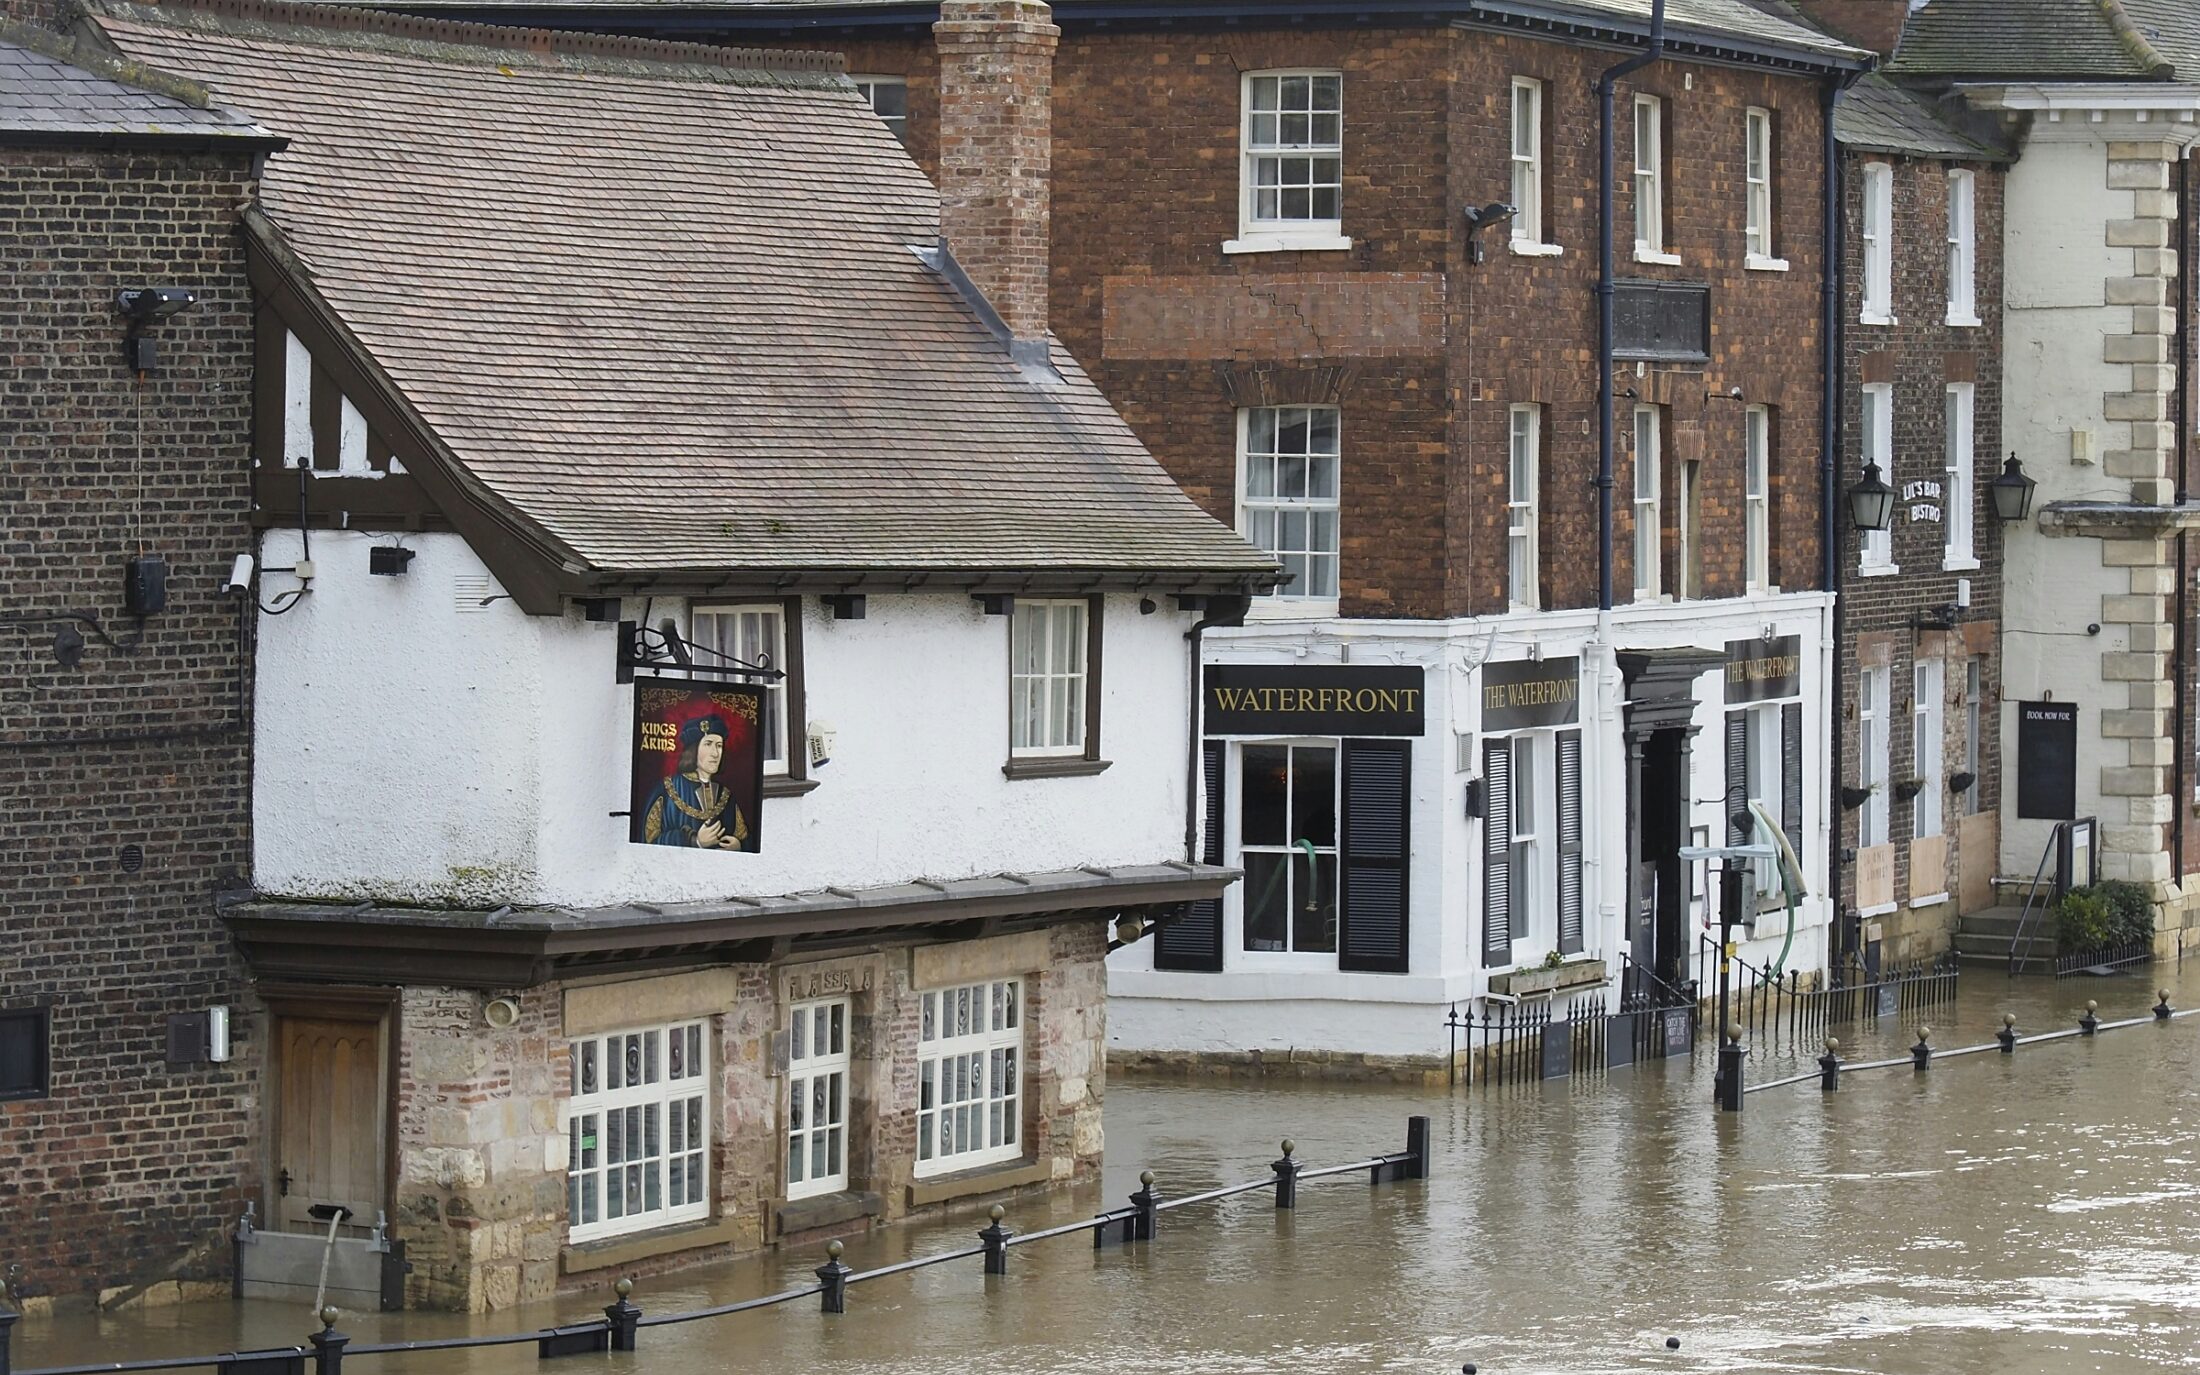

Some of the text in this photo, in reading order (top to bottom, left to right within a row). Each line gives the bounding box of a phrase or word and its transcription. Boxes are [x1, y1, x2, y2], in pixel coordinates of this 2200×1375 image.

[1903, 481, 1940, 501] LIL'S BAR
[1911, 504, 1940, 522] BISTRO
[1726, 655, 1799, 683] THE WATERFRONT
[1214, 688, 1419, 713] WATERFRONT
[1484, 679, 1578, 709] THE WATERFRONT
[2026, 710, 2070, 721] BOOK NOW FOR
[641, 722, 677, 737] KINGS
[640, 735, 676, 752] ARMS
